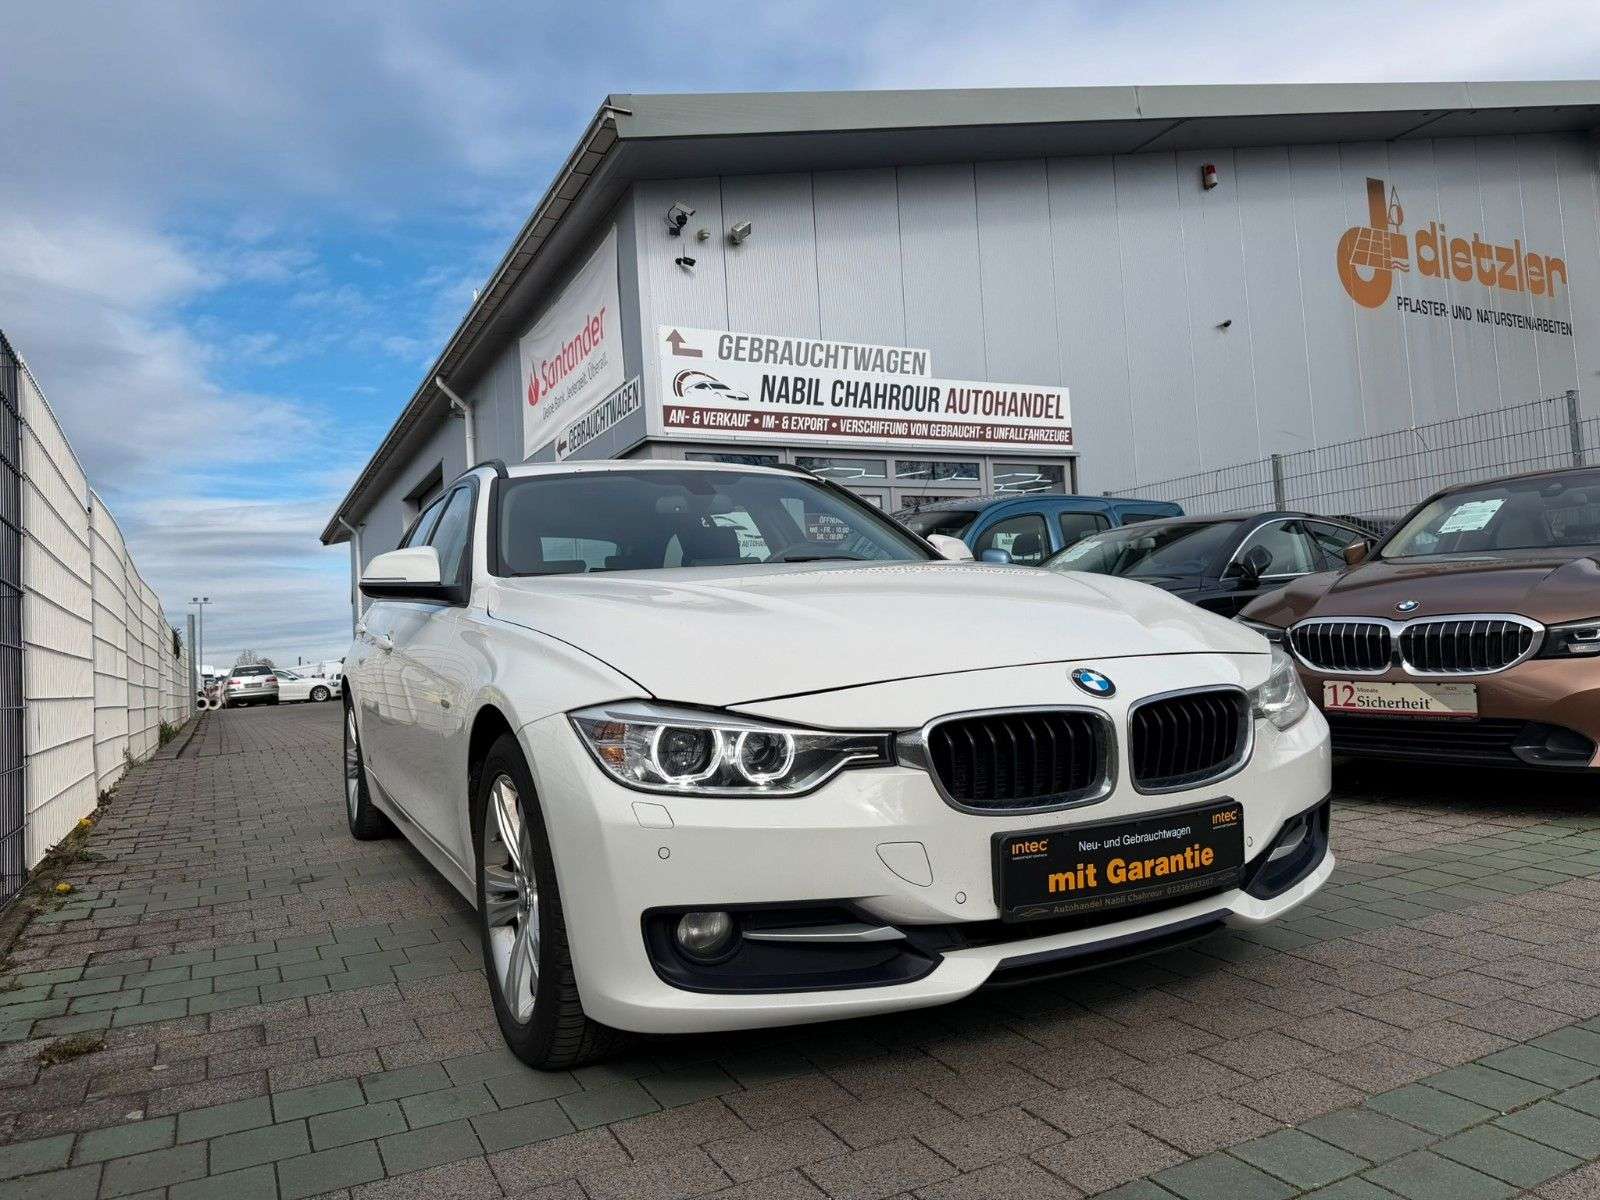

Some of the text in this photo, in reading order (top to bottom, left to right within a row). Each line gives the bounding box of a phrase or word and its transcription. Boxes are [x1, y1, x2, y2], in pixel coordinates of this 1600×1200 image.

[1415, 221, 1567, 297] dietzler
[1397, 296, 1573, 336] PFLASTER- UND NATURSTEINARBEITEN
[541, 305, 607, 396] Santander
[718, 334, 926, 376] GEBRAUCHTWAGEN
[568, 380, 639, 452] GEBRAUCHTWAGEN
[760, 374, 1064, 420] NABIL CHAHROUR AUTOHANDEL
[669, 409, 1070, 443] AN- & VERKAUF IM- & EXPORT VERSCHIFFUNG VON GEBRAUCHT- & UNFALLFAHRZEUGE
[1327, 684, 1357, 708] 12
[1078, 826, 1191, 852] Neu- und Gebrauchtwagen
[1048, 843, 1214, 893] mit Garantie
[1053, 899, 1103, 913] Autohandel
[1105, 895, 1126, 905] Nabil
